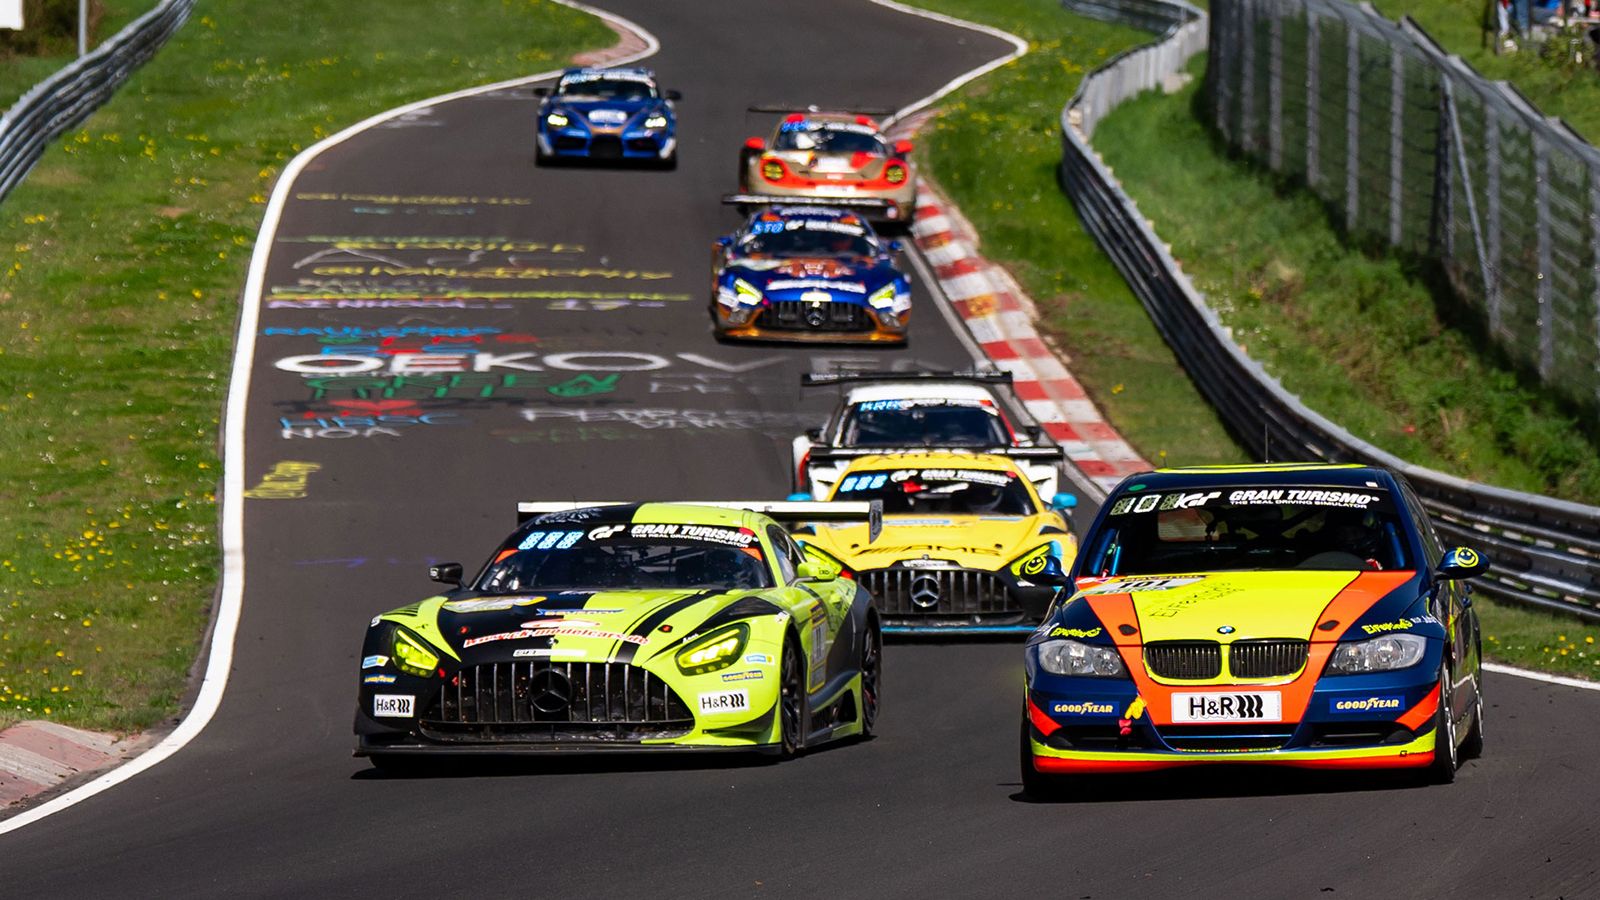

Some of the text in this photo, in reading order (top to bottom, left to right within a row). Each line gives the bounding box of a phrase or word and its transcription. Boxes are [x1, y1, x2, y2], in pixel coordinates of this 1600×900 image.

[1229, 490, 1284, 502] GRAN
[1314, 501, 1367, 509] SIMULATOR
[631, 524, 675, 536] GRAN
[704, 538, 748, 548] SIMULATOR
[376, 699, 396, 711] H&R
[702, 695, 728, 709] H&R
[1189, 697, 1235, 716] H&R
[1336, 697, 1400, 711] GOODYEAR
[1054, 702, 1113, 715] GOODYEAR
